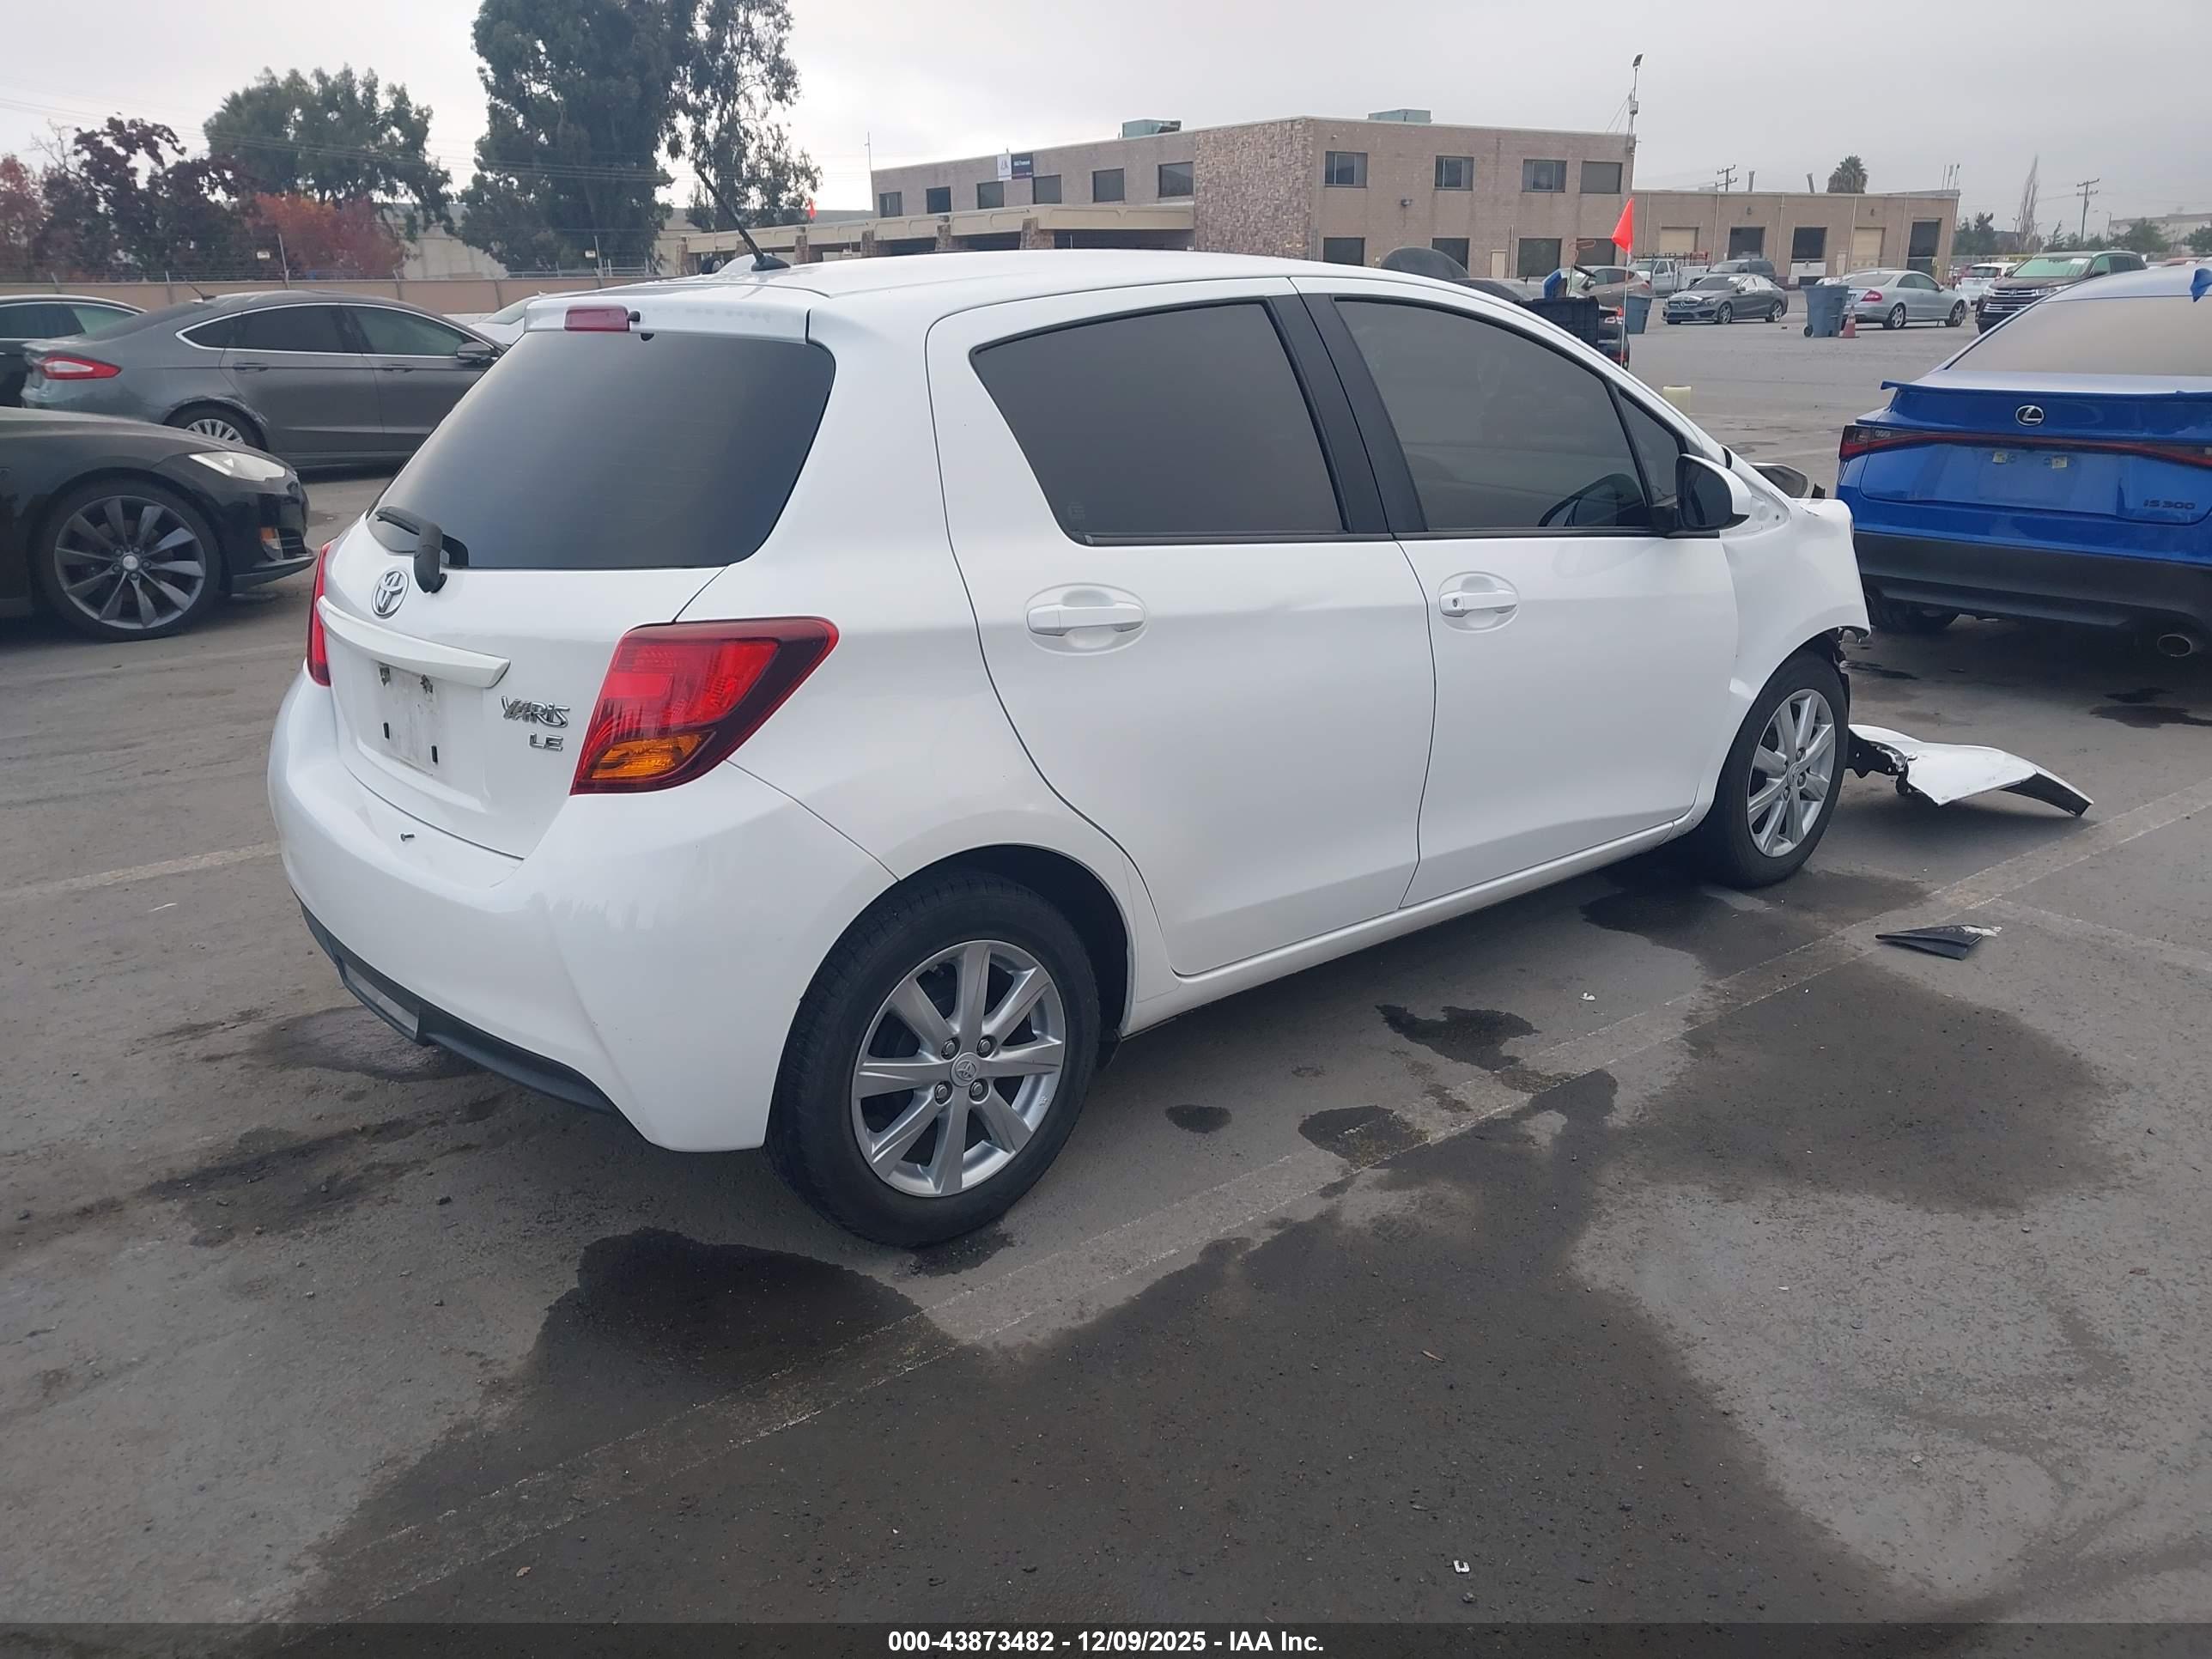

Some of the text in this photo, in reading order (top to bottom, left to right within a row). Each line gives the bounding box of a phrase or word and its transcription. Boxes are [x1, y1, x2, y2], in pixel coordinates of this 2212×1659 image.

[2143, 499, 2196, 510] IS 300
[529, 733, 564, 752] LE
